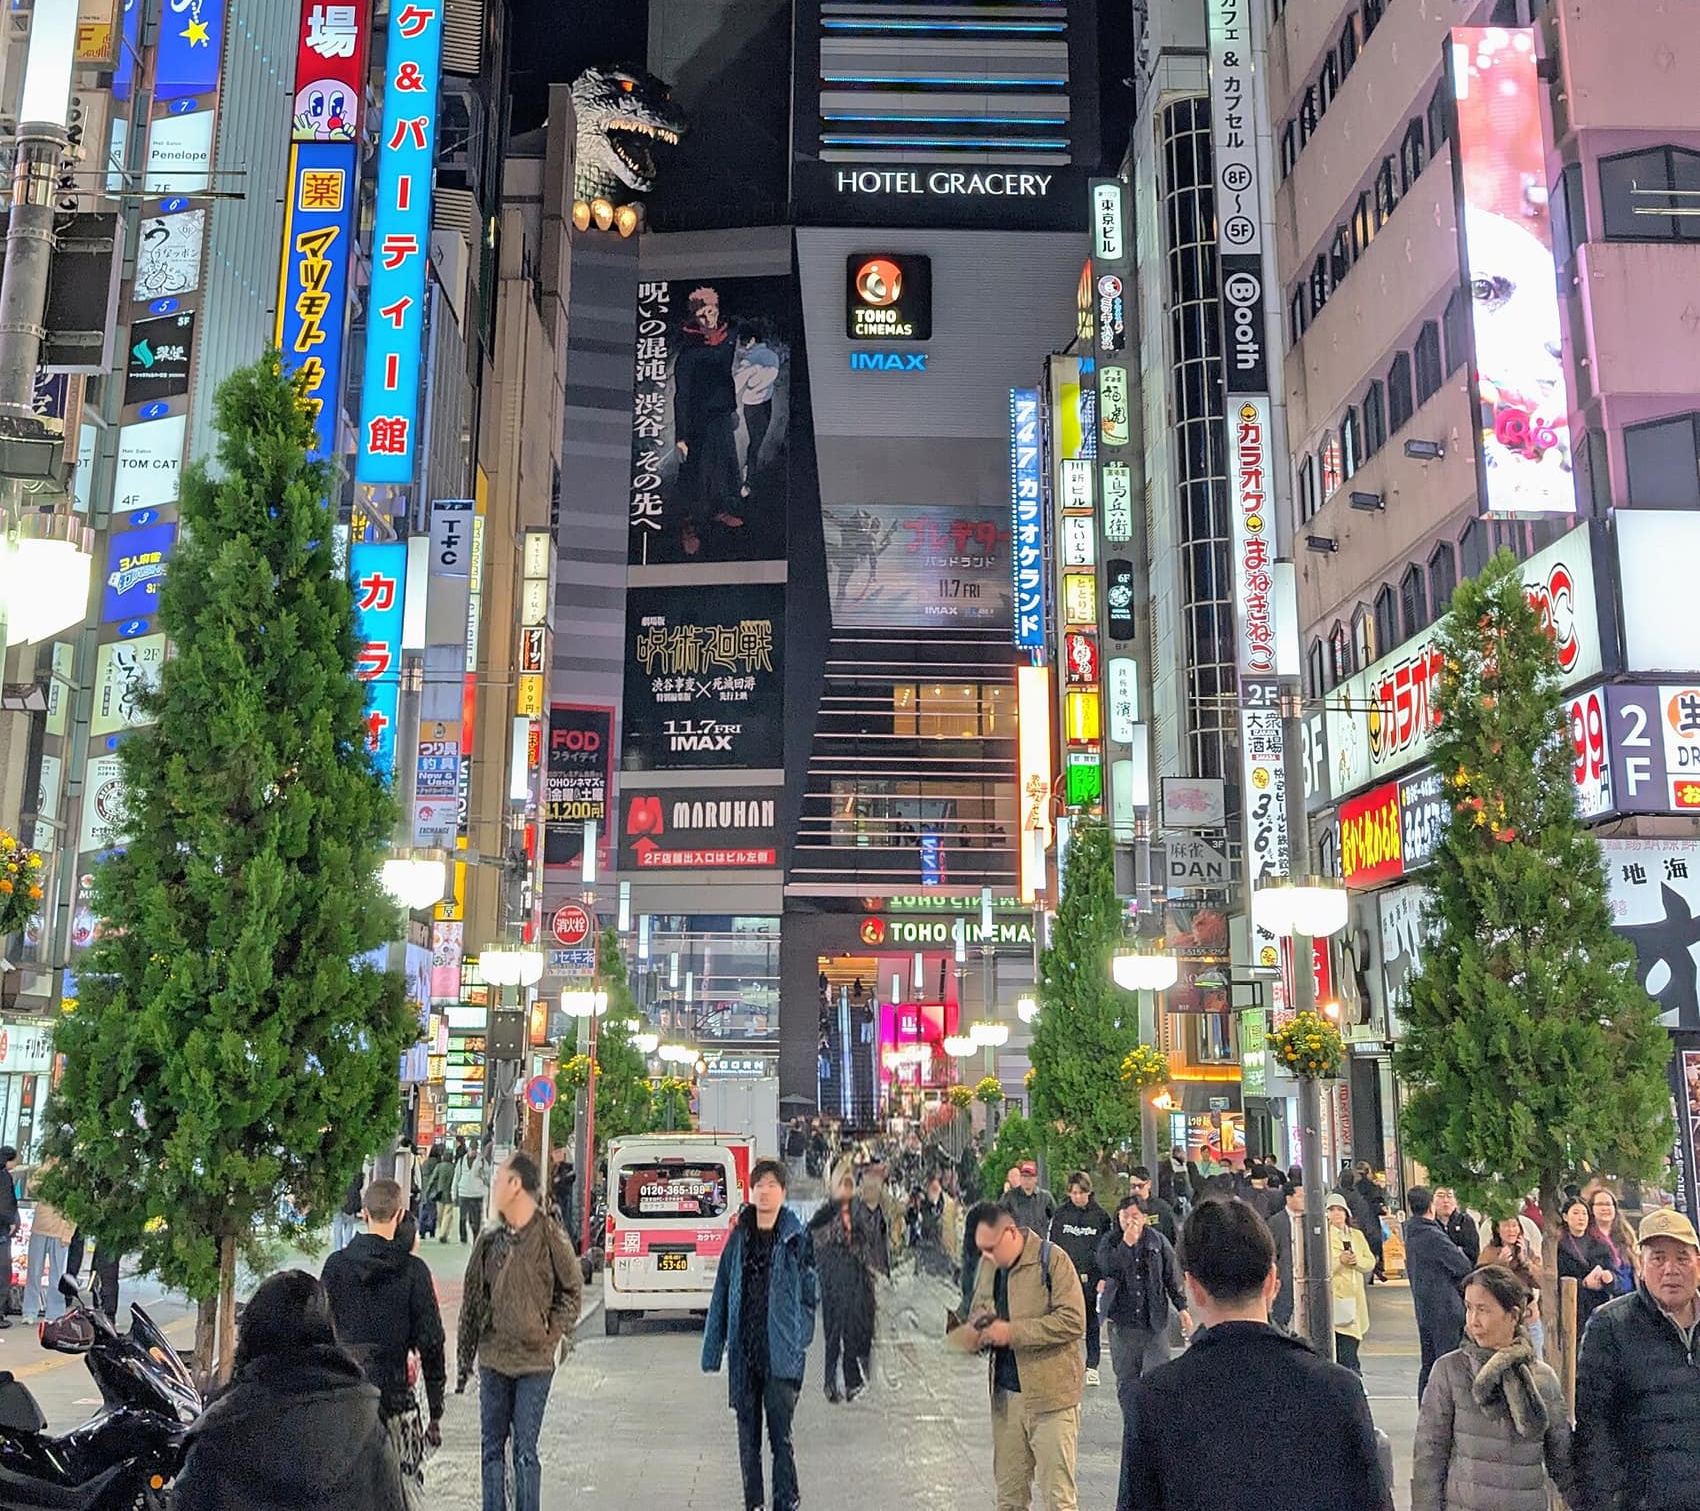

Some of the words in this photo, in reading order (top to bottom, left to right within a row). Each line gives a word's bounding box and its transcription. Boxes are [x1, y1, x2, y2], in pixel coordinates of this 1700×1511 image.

[151, 150, 208, 162] Penelope
[838, 170, 924, 194] HOTEL
[929, 171, 1052, 196] GRACERY
[1228, 170, 1247, 184] 8F
[306, 173, 339, 206] 薬
[1101, 199, 1116, 253] 東京ビル
[1230, 224, 1250, 238] 5F
[855, 309, 897, 324] TOHO
[1225, 272, 1261, 370] Booth
[855, 323, 913, 336] CINEMAS
[850, 352, 926, 372] IMAX
[121, 458, 149, 469] TOM
[152, 458, 179, 470] CAT
[122, 495, 141, 506] 4F
[903, 514, 1010, 554] プレデター
[925, 556, 996, 568] バッドランド
[1118, 573, 1131, 583] 6F
[939, 578, 961, 598] 11.7
[963, 584, 980, 598] FRI
[925, 606, 958, 615] IMAX
[529, 629, 543, 664] ダーツ
[637, 620, 773, 675] 呪術廻戦
[143, 647, 161, 663] 2F
[1247, 684, 1278, 706] 2F
[1247, 711, 1282, 729] 大衆
[552, 728, 601, 751] FOD
[671, 736, 733, 752] IMAX
[1248, 737, 1283, 754] 酒場
[420, 742, 458, 756] つり具
[418, 772, 443, 780] New
[672, 800, 775, 829] MARUHAN
[1170, 843, 1204, 859] 麻雀
[1212, 840, 1224, 849] 3F
[644, 851, 769, 864] 2F店舗出入口はビル左側
[1171, 862, 1223, 877] DAN
[556, 917, 586, 933] 消火栓
[890, 922, 947, 942] TOHO
[708, 1061, 764, 1070] ACORN
[696, 1234, 722, 1242] カクヤス
